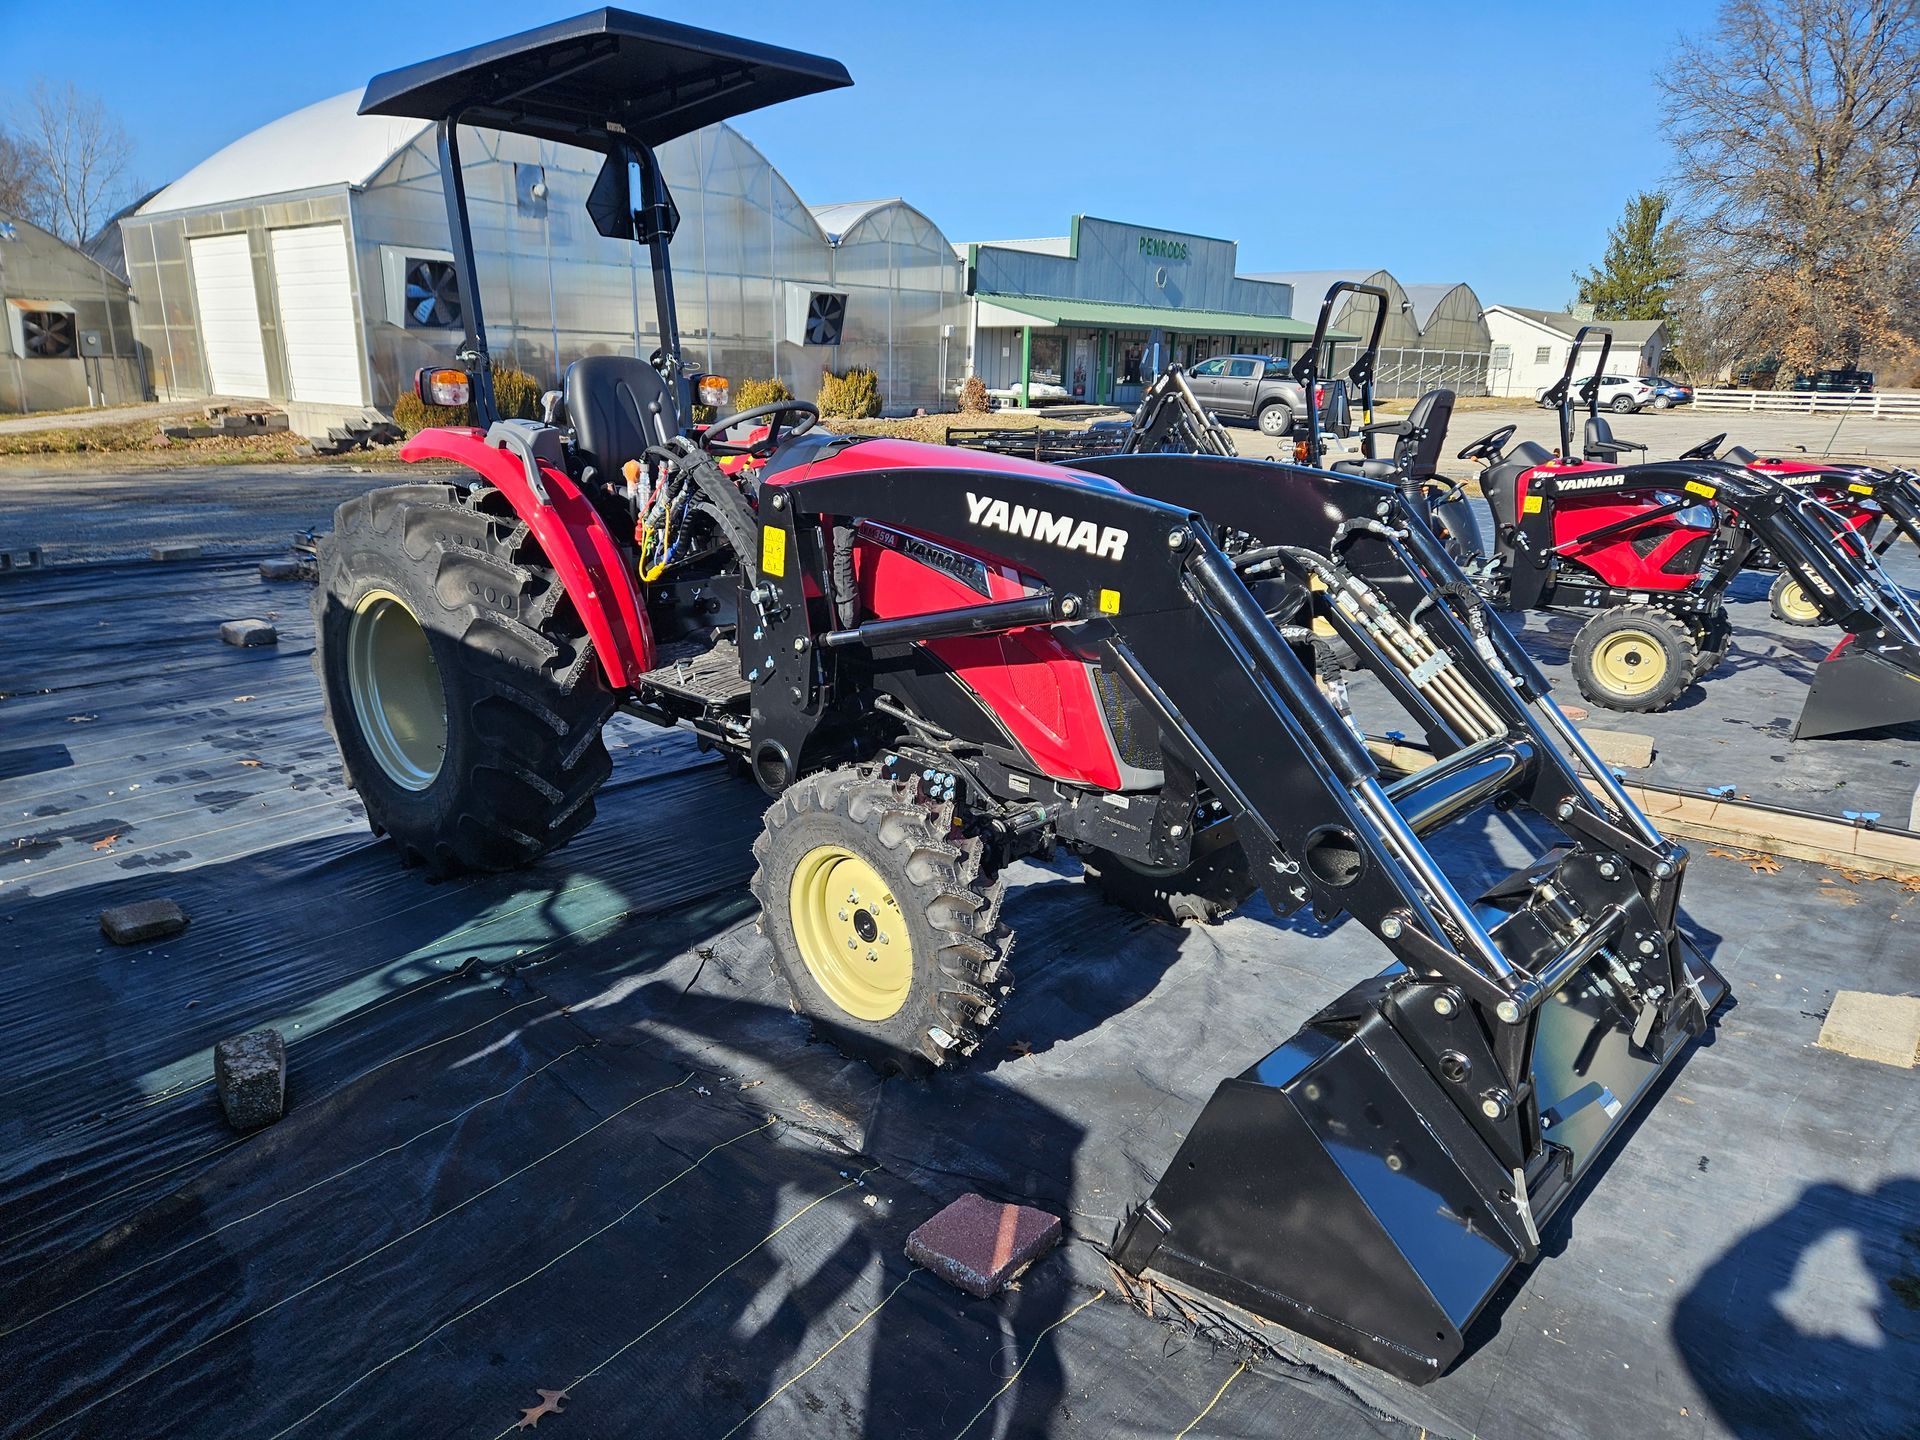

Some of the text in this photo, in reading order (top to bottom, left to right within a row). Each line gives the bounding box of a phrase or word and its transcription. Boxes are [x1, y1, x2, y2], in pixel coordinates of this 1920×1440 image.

[1138, 236, 1187, 260] PENRODS
[1556, 475, 1625, 491] YANMAR
[1780, 474, 1821, 486] NMAR
[965, 491, 1129, 561] YANMAR
[1800, 562, 1835, 595] YL210
